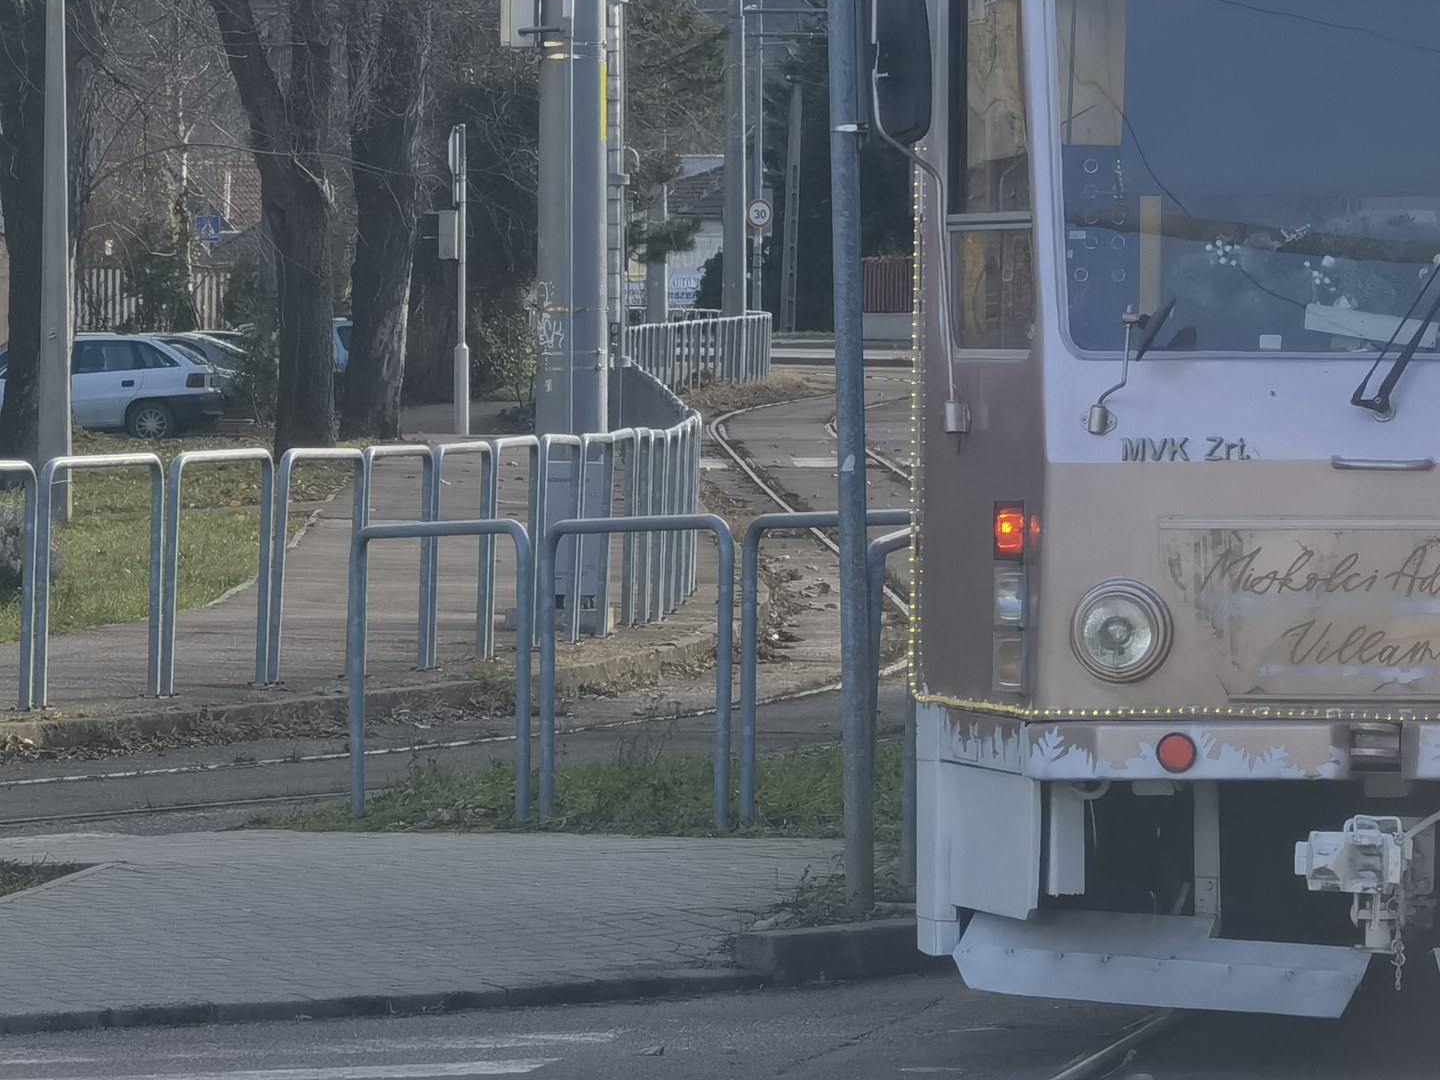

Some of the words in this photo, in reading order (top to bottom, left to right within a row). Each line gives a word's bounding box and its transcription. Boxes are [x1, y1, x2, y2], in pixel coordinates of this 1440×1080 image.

[753, 208, 767, 220] 30
[1120, 436, 1191, 463] MVK
[1204, 435, 1252, 462] Zrt.
[1200, 546, 1380, 596] Miskolci
